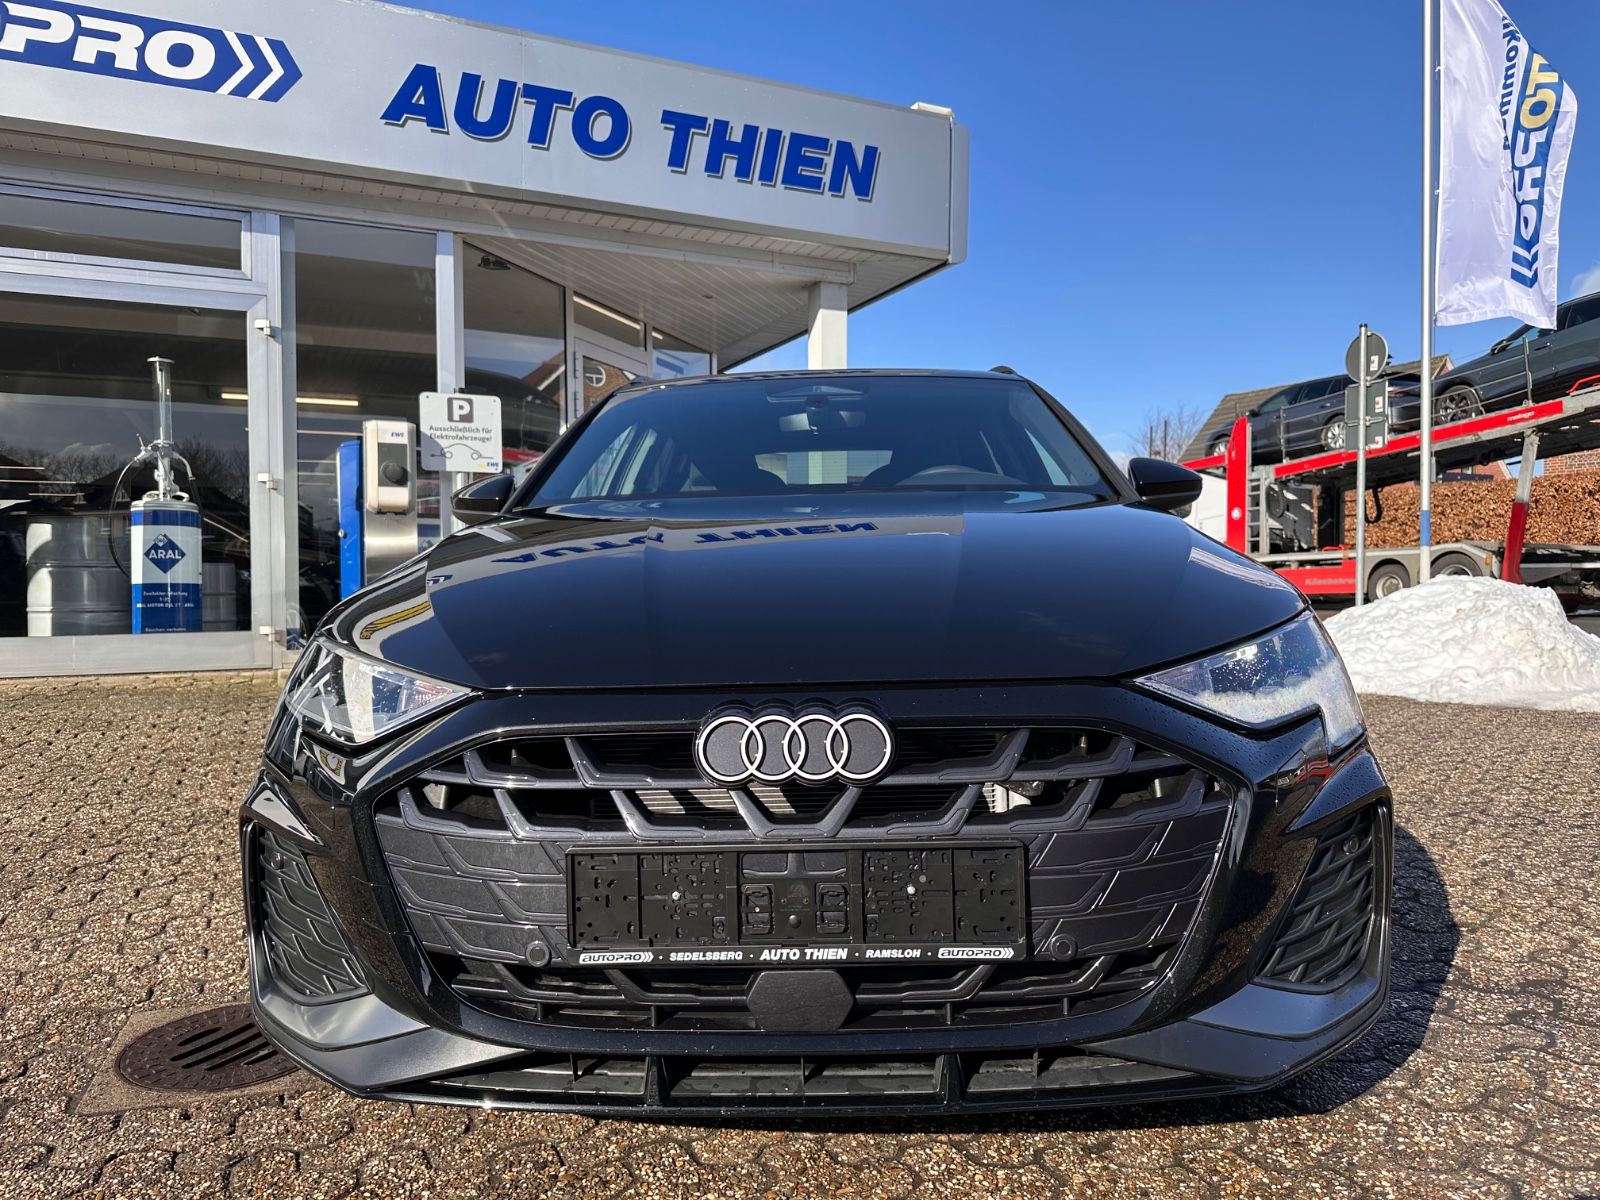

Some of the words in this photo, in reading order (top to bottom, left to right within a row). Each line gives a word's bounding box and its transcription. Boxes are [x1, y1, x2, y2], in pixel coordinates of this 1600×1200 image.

[379, 63, 630, 158] AUTO
[660, 109, 880, 199] THIEN
[453, 400, 471, 421] P
[429, 425, 480, 434] Ausschließlich
[481, 426, 492, 434] für
[149, 550, 181, 559] ARAL
[669, 952, 743, 961] SEDELSBERG
[760, 949, 800, 961] AUTO
[804, 948, 848, 960] THIEN
[865, 949, 921, 958] RAMSLOH
